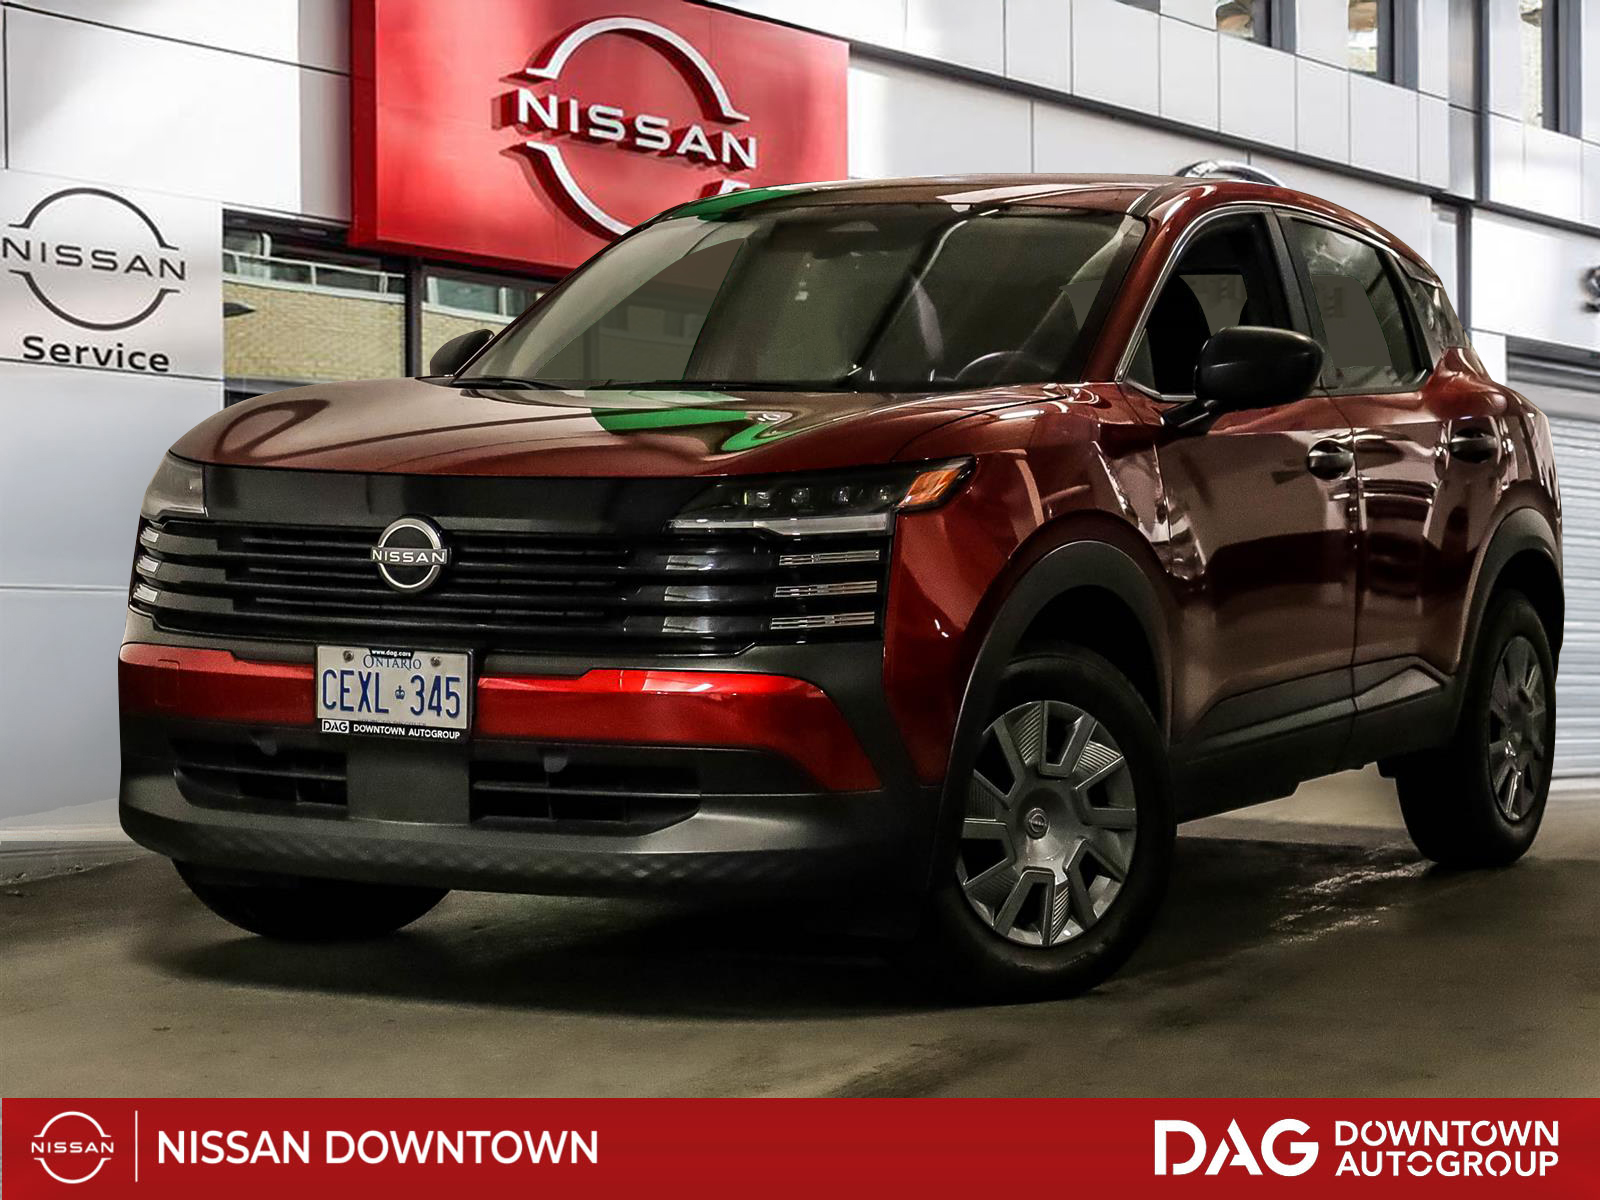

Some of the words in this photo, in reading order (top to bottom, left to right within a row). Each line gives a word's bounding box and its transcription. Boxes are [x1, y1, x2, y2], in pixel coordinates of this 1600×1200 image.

[518, 88, 757, 169] NISSAN
[2, 237, 185, 281] NISSAN
[22, 335, 169, 372] Service
[372, 550, 445, 563] NISSAN
[322, 669, 389, 713] CEXL
[410, 675, 461, 718] 345
[323, 720, 348, 733] DAG
[353, 724, 406, 735] DOWNTOWN
[408, 728, 460, 740] AUTOGROUP
